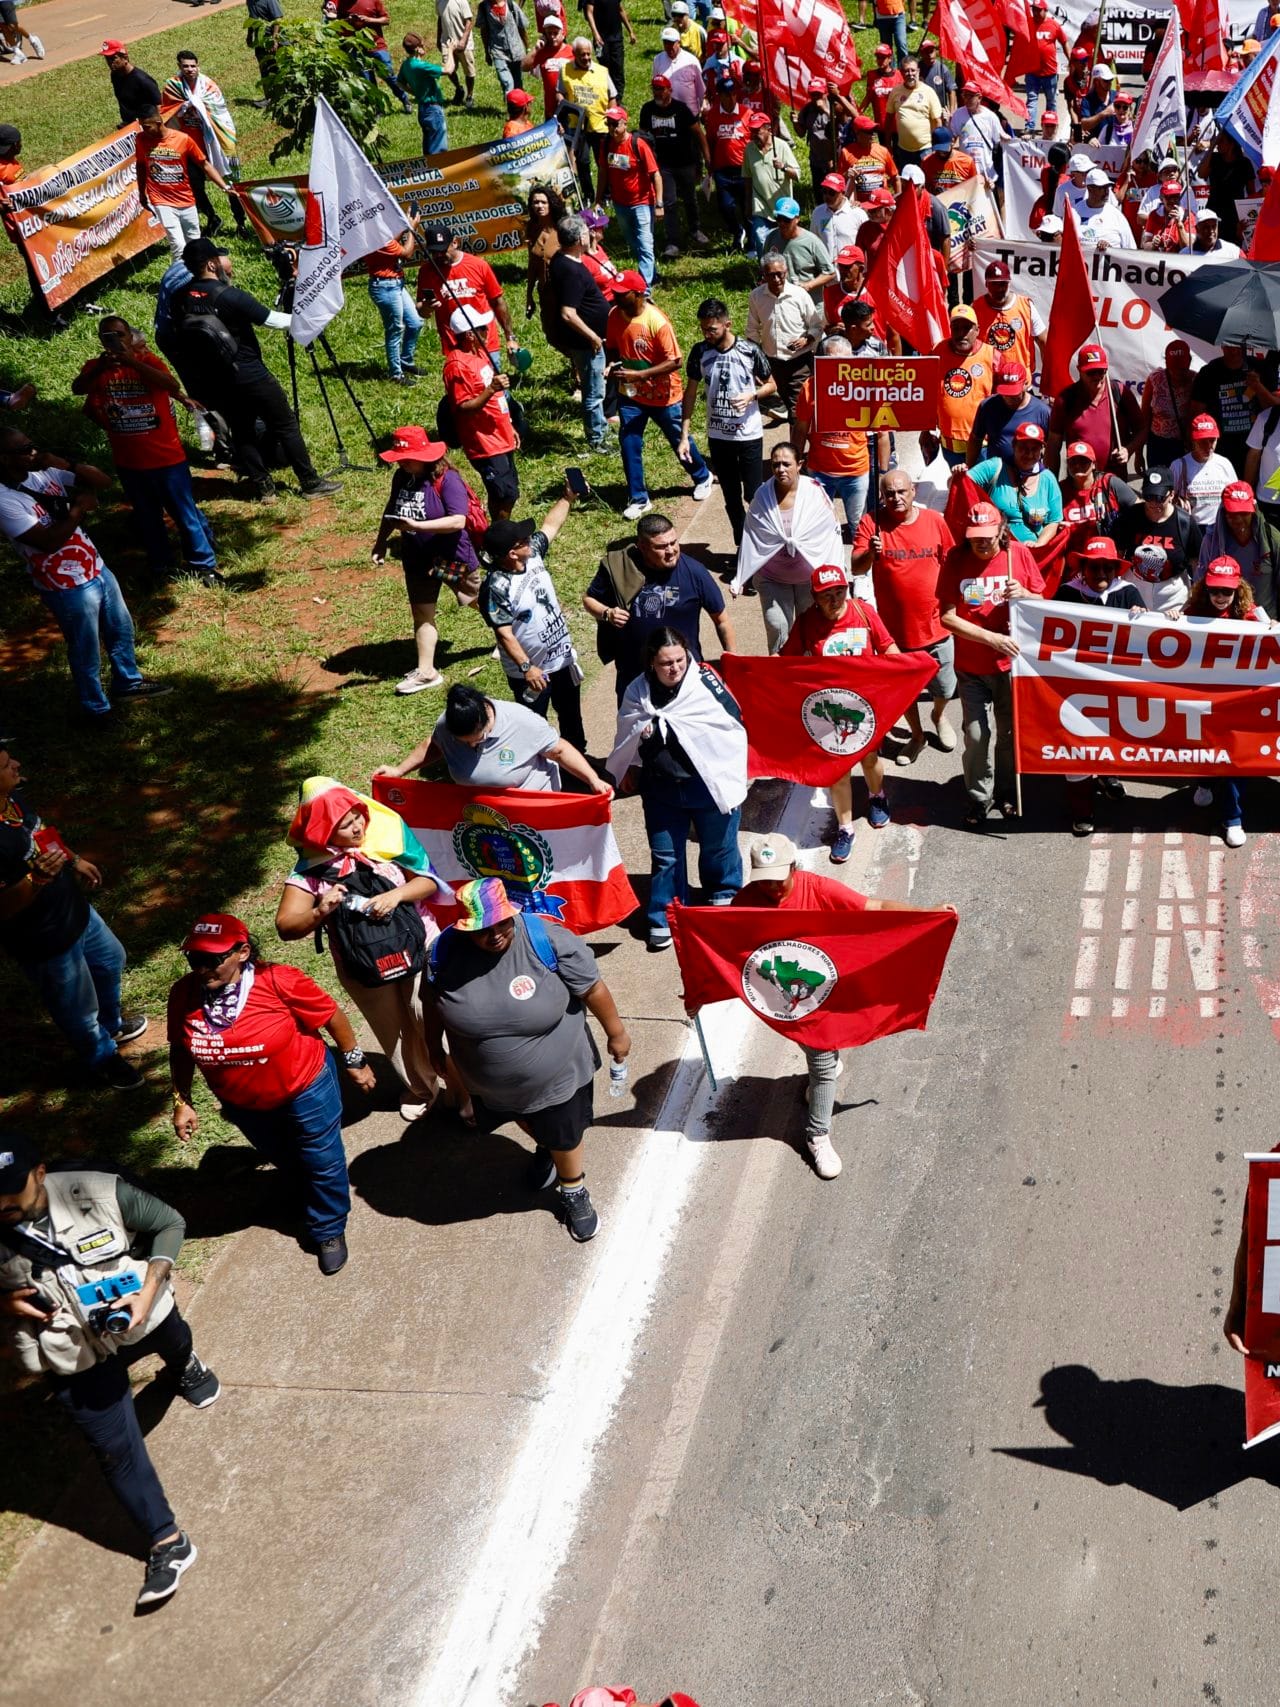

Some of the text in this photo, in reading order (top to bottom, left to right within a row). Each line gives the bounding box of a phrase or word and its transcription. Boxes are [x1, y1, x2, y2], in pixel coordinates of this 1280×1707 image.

[1036, 31, 1051, 40] UT
[487, 138, 552, 167] TRANSFORMA
[513, 151, 546, 169] CIDADE!
[1022, 155, 1046, 169] FIM
[412, 168, 444, 184] LUTA
[344, 216, 358, 231] DE
[420, 203, 523, 231] TRABALHADORES
[296, 254, 332, 296] SINDICATO
[838, 363, 917, 386] Redução
[828, 382, 924, 401] de Jornada
[846, 402, 900, 428] JÁ
[1037, 616, 1193, 669] PELO
[1059, 692, 1213, 741] CUT
[1041, 745, 1233, 766] SANTA CATARINA
[760, 941, 821, 957] TRABALHADORES
[821, 954, 836, 978] RURAIS
[223, 1043, 265, 1057] passar
